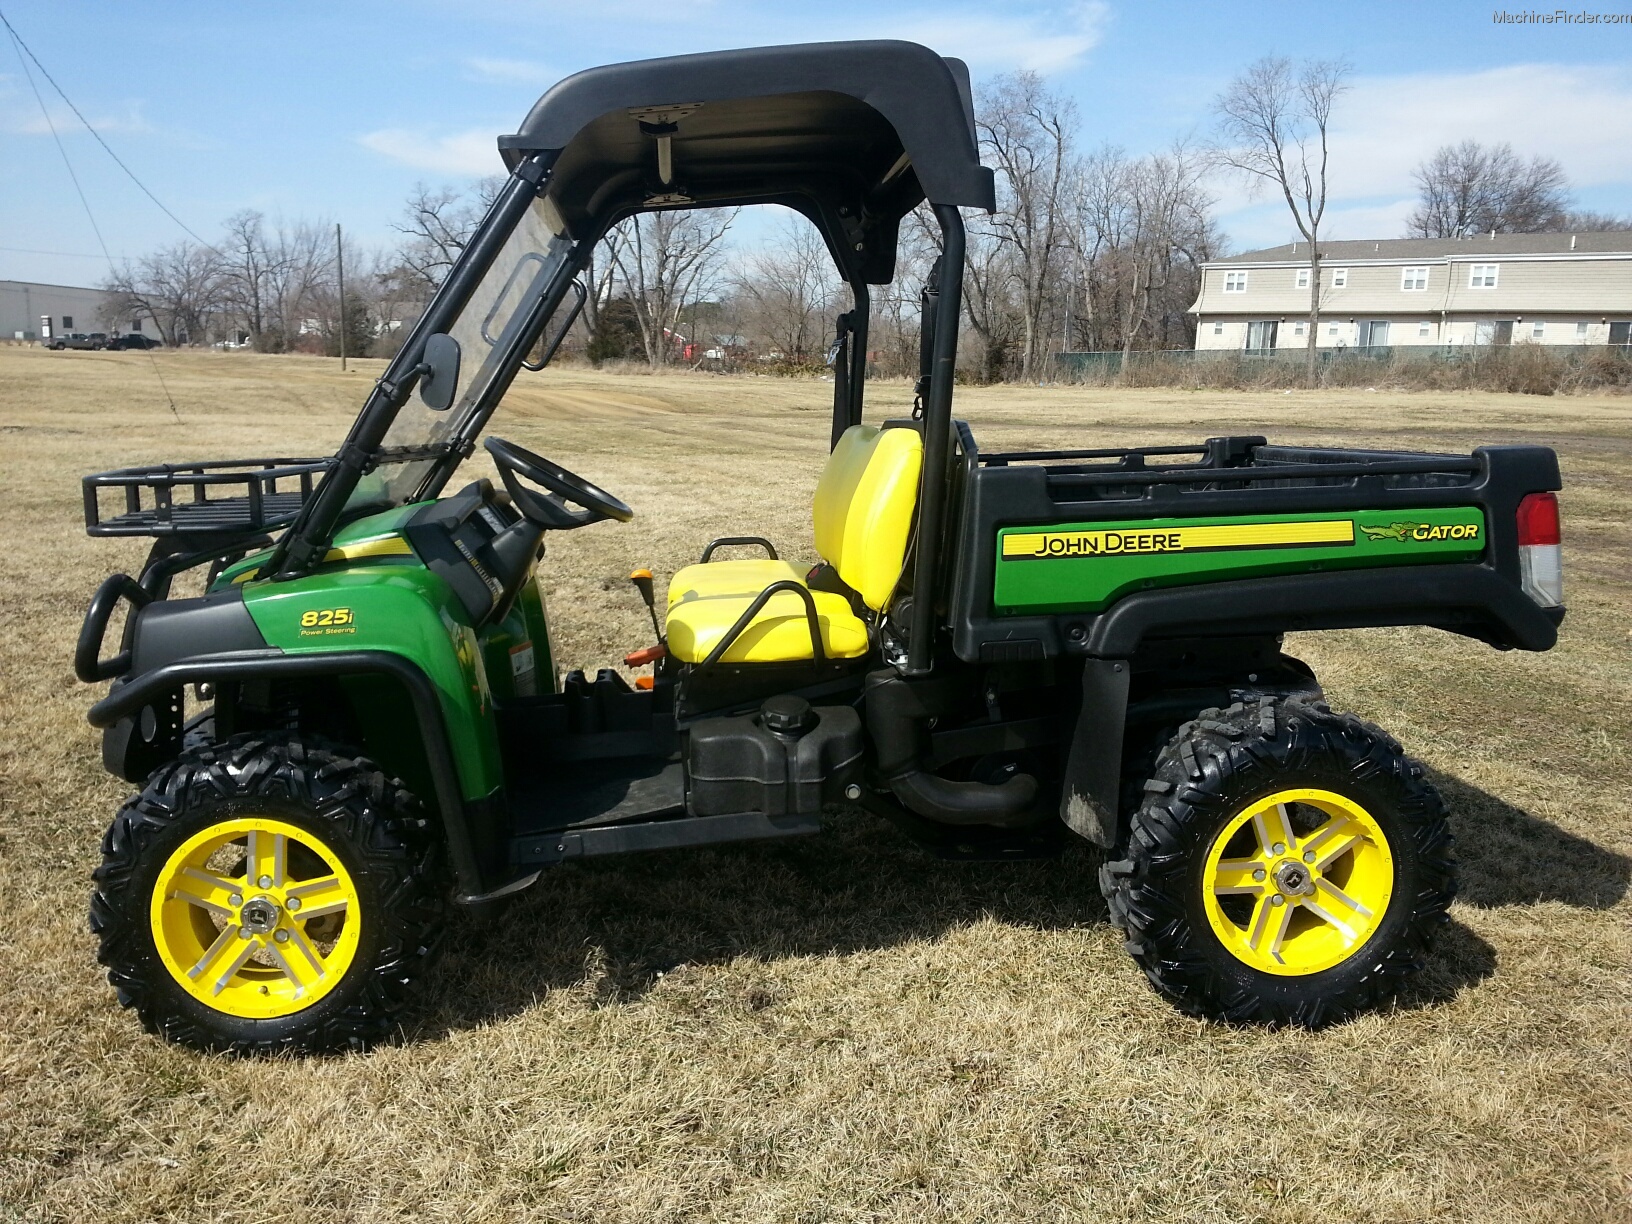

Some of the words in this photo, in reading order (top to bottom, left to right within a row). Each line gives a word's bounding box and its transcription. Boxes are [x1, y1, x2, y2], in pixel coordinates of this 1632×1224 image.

[1412, 523, 1479, 540] GATOR
[1034, 535, 1099, 555] JOHN
[1105, 532, 1182, 552] DEERE
[300, 608, 354, 627] 825i
[325, 627, 356, 635] Steering
